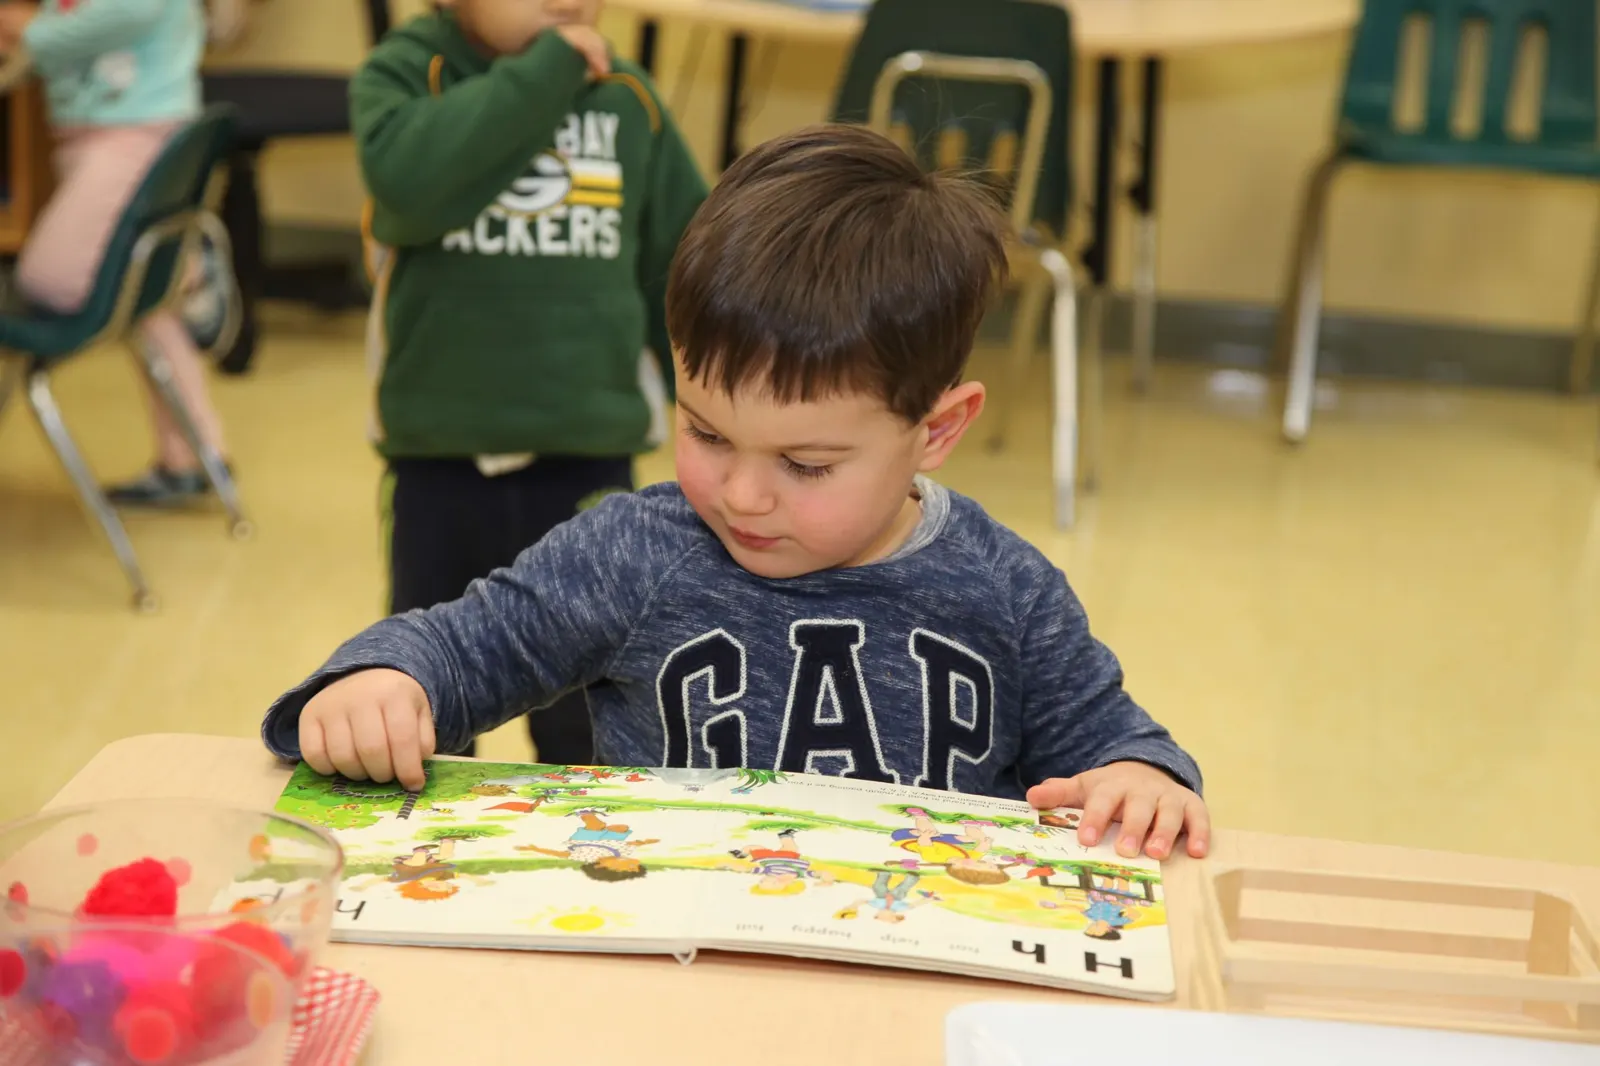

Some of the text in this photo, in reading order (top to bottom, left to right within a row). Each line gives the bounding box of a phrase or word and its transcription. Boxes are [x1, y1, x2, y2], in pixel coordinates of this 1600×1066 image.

[555, 110, 619, 158] BAY
[656, 619, 994, 791] GAP
[1012, 940, 1046, 964] h
[1084, 951, 1134, 979] H
